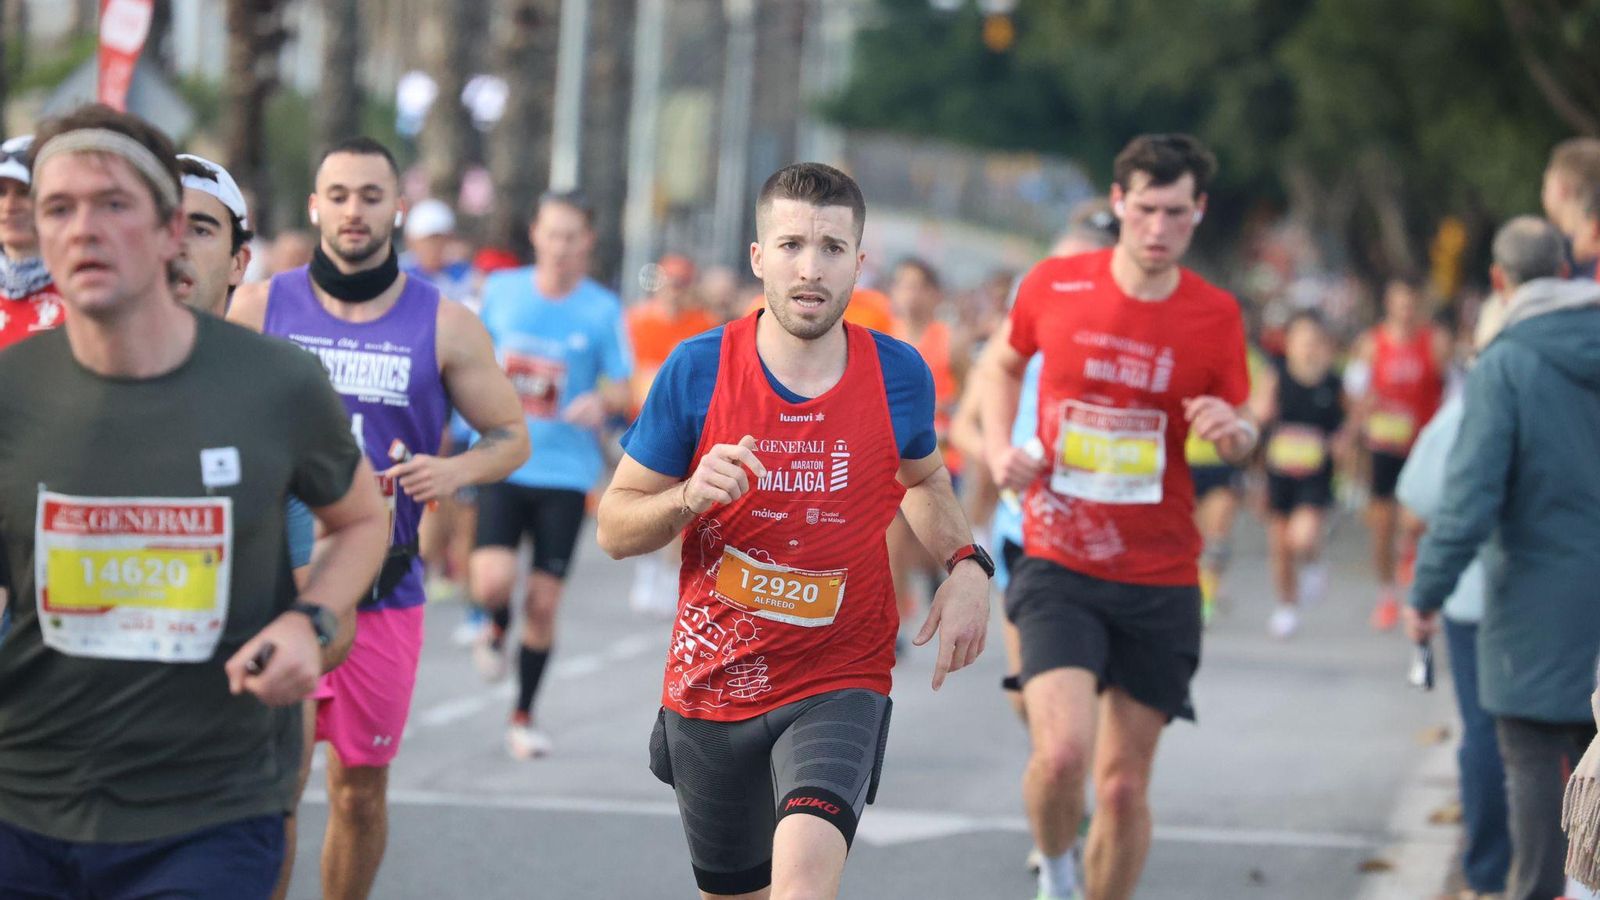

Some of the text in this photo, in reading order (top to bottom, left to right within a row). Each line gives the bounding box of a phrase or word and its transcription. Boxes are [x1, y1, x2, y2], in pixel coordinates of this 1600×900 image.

[780, 412, 813, 422] luanvi
[760, 439, 825, 454] GENERALI
[791, 459, 824, 470] MARATÓN
[757, 467, 825, 493] MÁLAGA
[88, 507, 214, 533] GENERALI
[828, 516, 846, 524] Málaga
[80, 556, 188, 588] 14620
[741, 567, 819, 603] 12920
[754, 596, 795, 610] ALFREDO
[784, 797, 841, 815] HOKO
